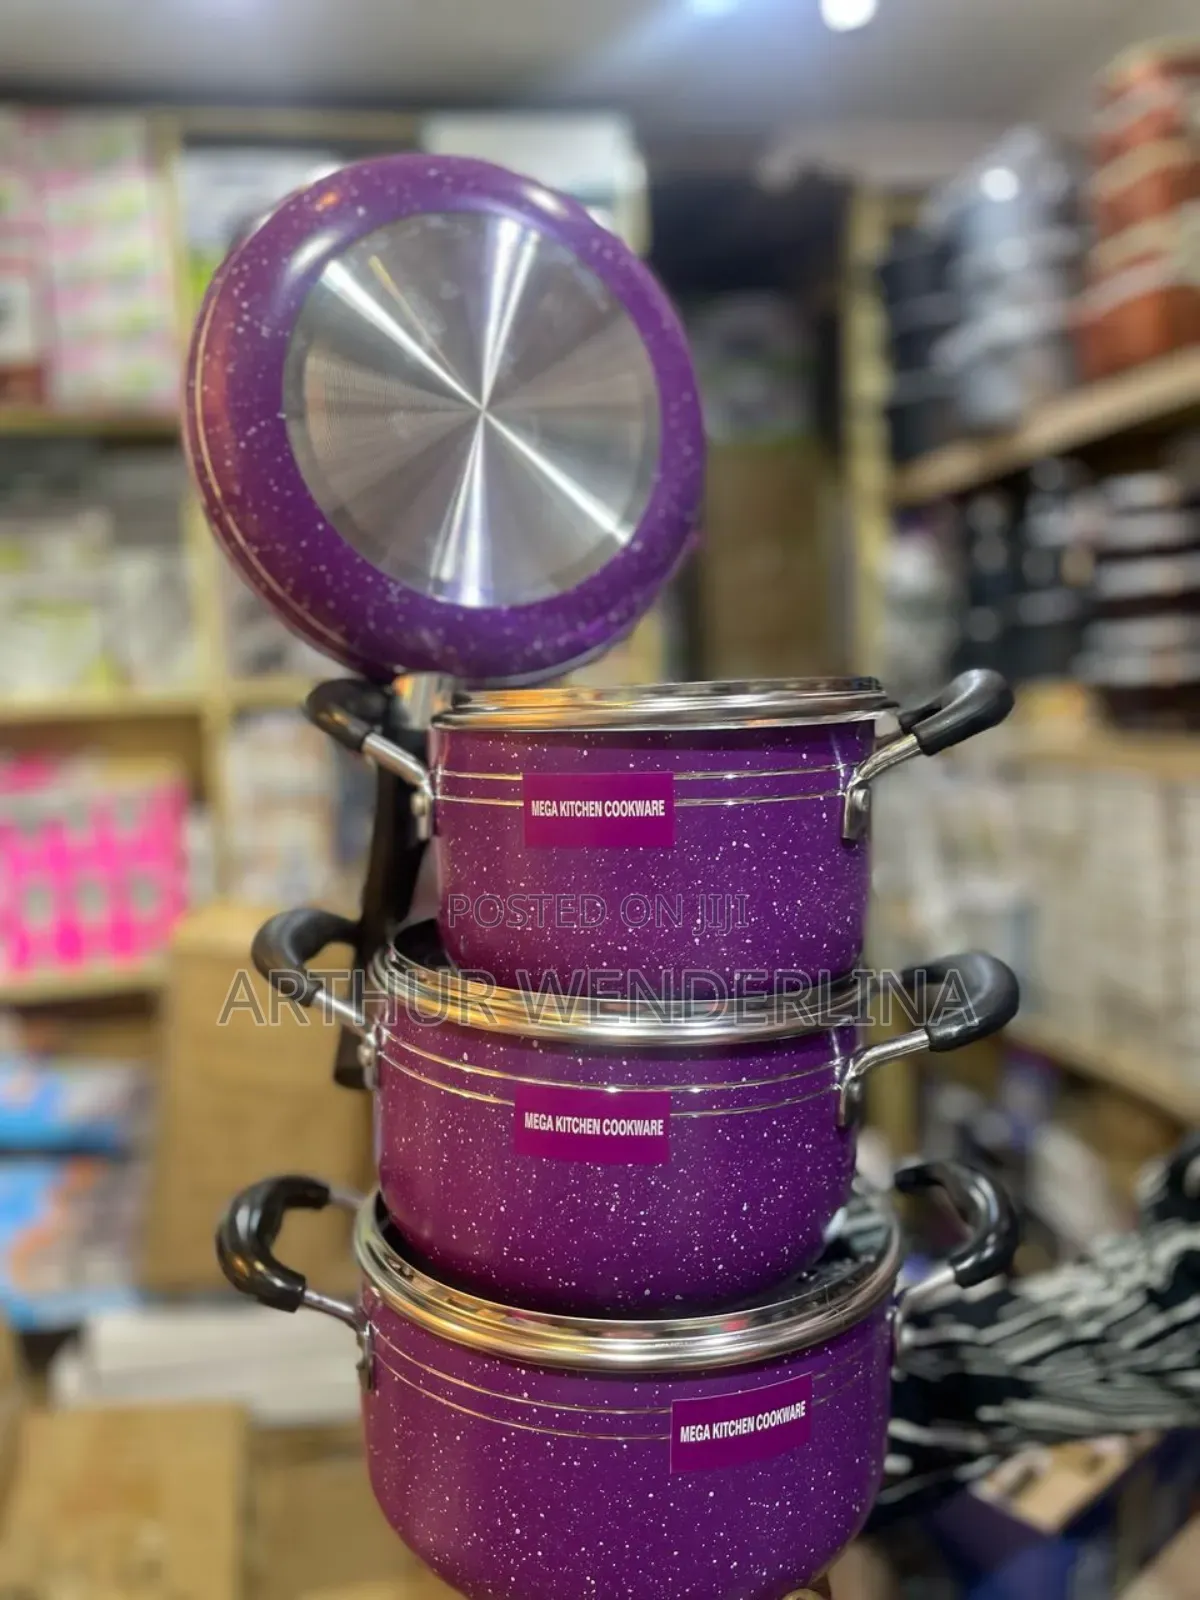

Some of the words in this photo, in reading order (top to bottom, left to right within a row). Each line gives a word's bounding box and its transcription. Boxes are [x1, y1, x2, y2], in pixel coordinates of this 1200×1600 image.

[531, 800, 558, 817] MEGA
[560, 800, 602, 817] KITCHEN
[604, 800, 665, 817] COOKWARE
[524, 1112, 554, 1131] MEGA
[555, 1115, 600, 1135] KITCHEN
[602, 1119, 664, 1136] COOKWARE
[680, 1424, 710, 1442] MEGA
[712, 1416, 755, 1439] KITCHEN
[756, 1400, 806, 1431] COOKWARE
